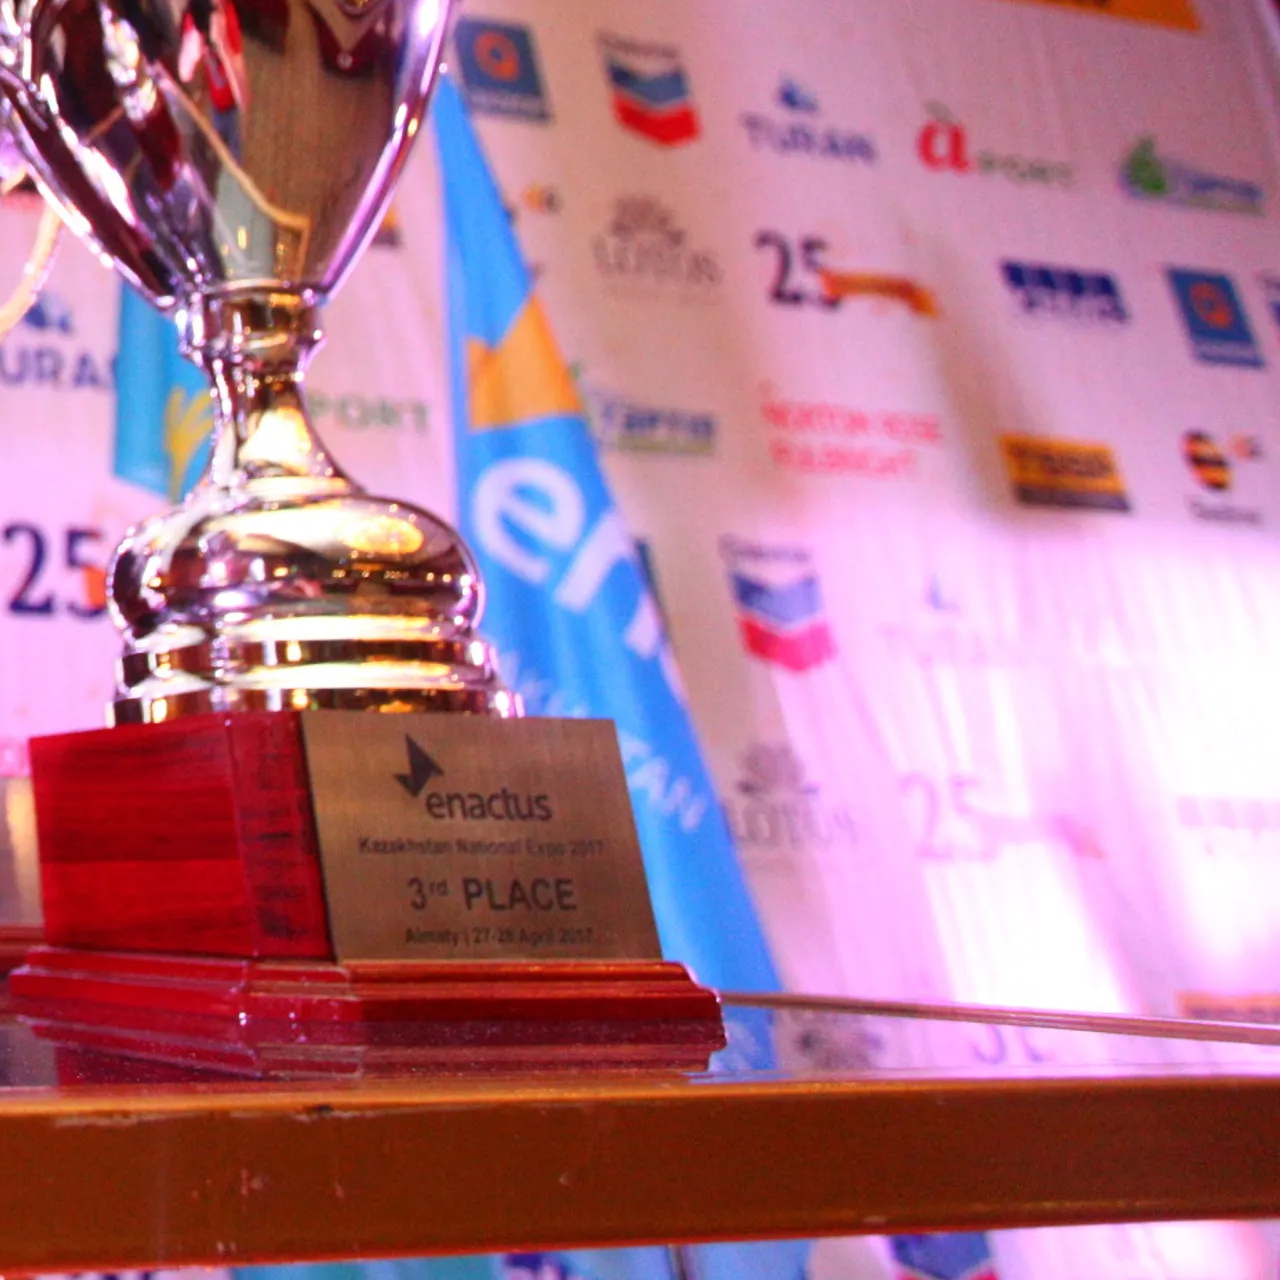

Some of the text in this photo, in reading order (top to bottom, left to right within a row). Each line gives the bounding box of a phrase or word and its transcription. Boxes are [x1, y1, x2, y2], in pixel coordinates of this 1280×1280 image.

[754, 231, 840, 312] 25
[306, 391, 429, 436] PORT
[2, 522, 107, 621] 25
[425, 788, 552, 821] enactus
[408, 877, 577, 911] 3rd PLACE
